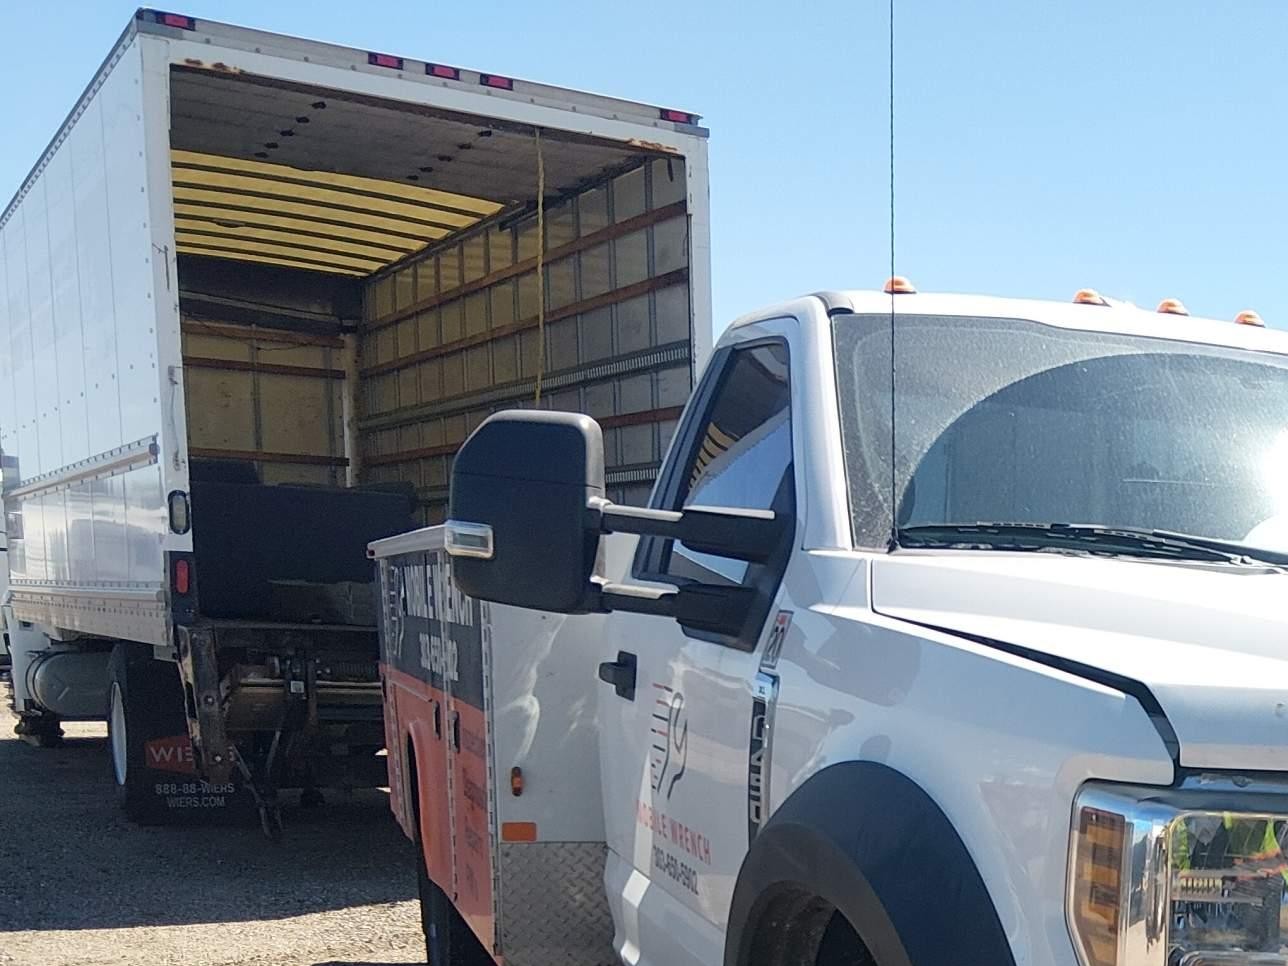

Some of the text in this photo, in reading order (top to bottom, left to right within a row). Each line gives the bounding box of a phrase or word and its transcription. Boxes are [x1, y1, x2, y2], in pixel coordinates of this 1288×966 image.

[155, 783, 235, 795] 888-88-WIERS
[167, 796, 225, 809] WIERS.COM
[670, 820, 712, 866] WRENCH
